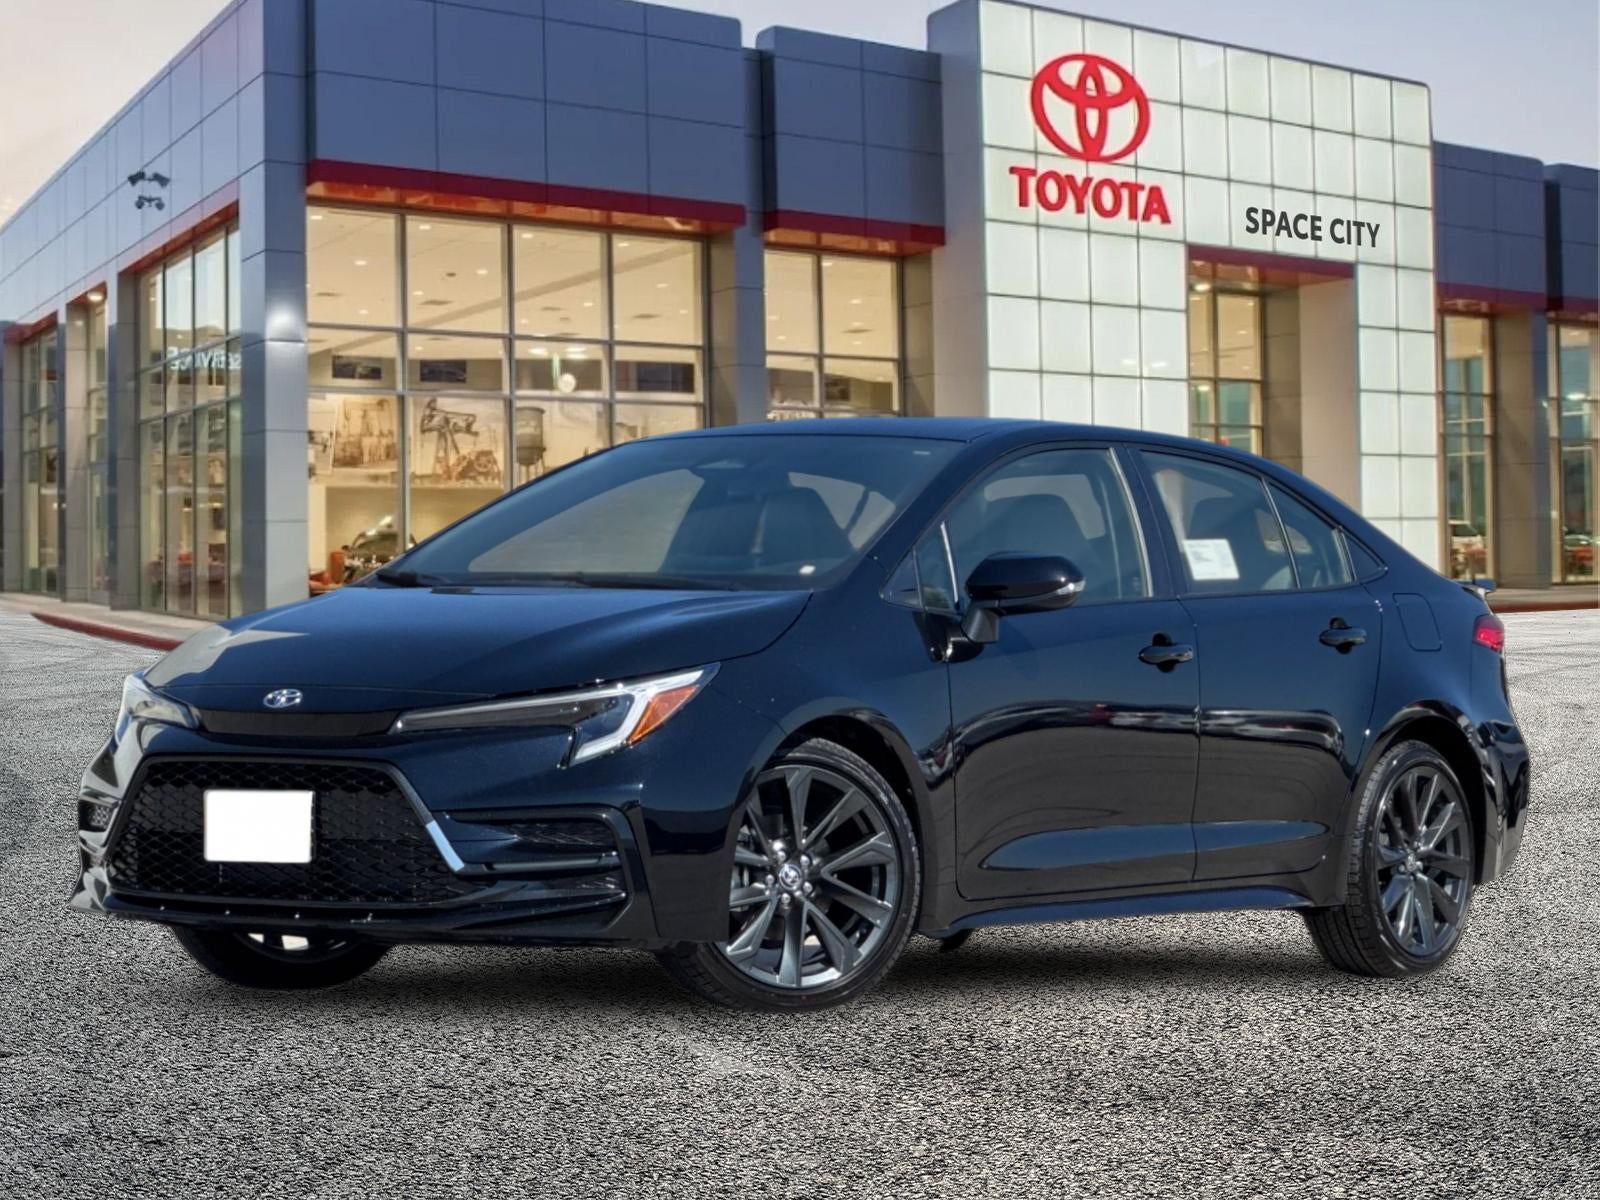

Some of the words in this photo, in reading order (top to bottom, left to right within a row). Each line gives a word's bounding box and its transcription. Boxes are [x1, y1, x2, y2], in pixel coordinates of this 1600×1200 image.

[1009, 166, 1171, 224] TOYOTA
[1245, 206, 1322, 242] SPACE
[1329, 218, 1381, 248] CITY
